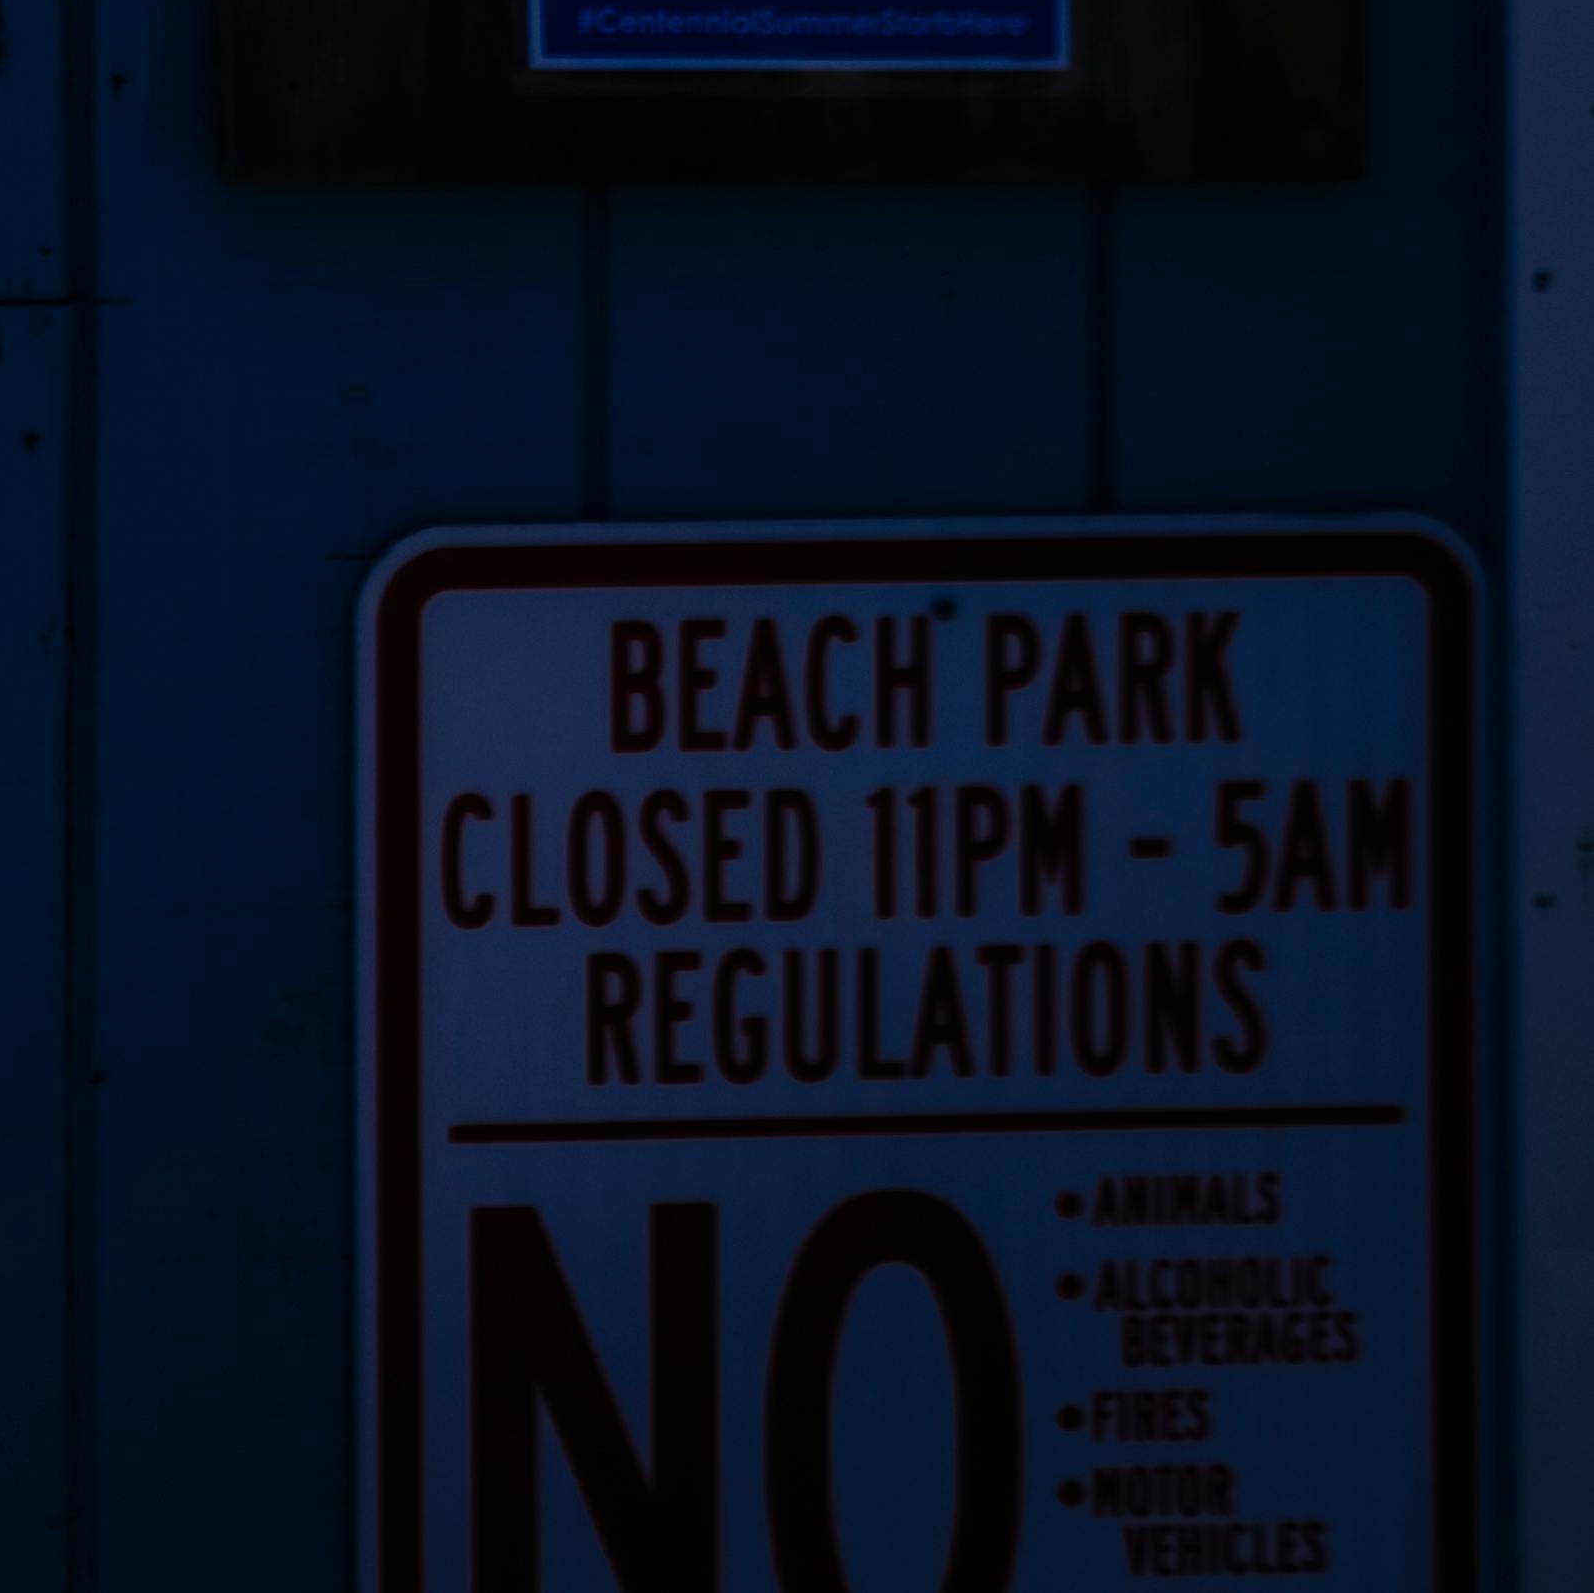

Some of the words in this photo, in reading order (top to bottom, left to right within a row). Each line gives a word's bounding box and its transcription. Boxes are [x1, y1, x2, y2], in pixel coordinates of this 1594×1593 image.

[609, 612, 933, 754] BEACH
[979, 608, 1243, 747] PARK
[439, 789, 821, 930] CLOSED
[865, 782, 1085, 922] 11PM
[1127, 834, 1173, 860] -
[1211, 776, 1413, 916] 5AM
[585, 938, 1268, 1087] REGULATIONS
[1091, 1170, 1283, 1228] ANIMALS
[1091, 1254, 1336, 1311] ALCOHOLIC
[1118, 1311, 1361, 1369] BEVERAGES
[468, 1188, 1025, 1593] NO
[1091, 1388, 1213, 1444] FIRES
[1091, 1462, 1236, 1520] MOTOR
[1122, 1519, 1331, 1578] VEHICLES
